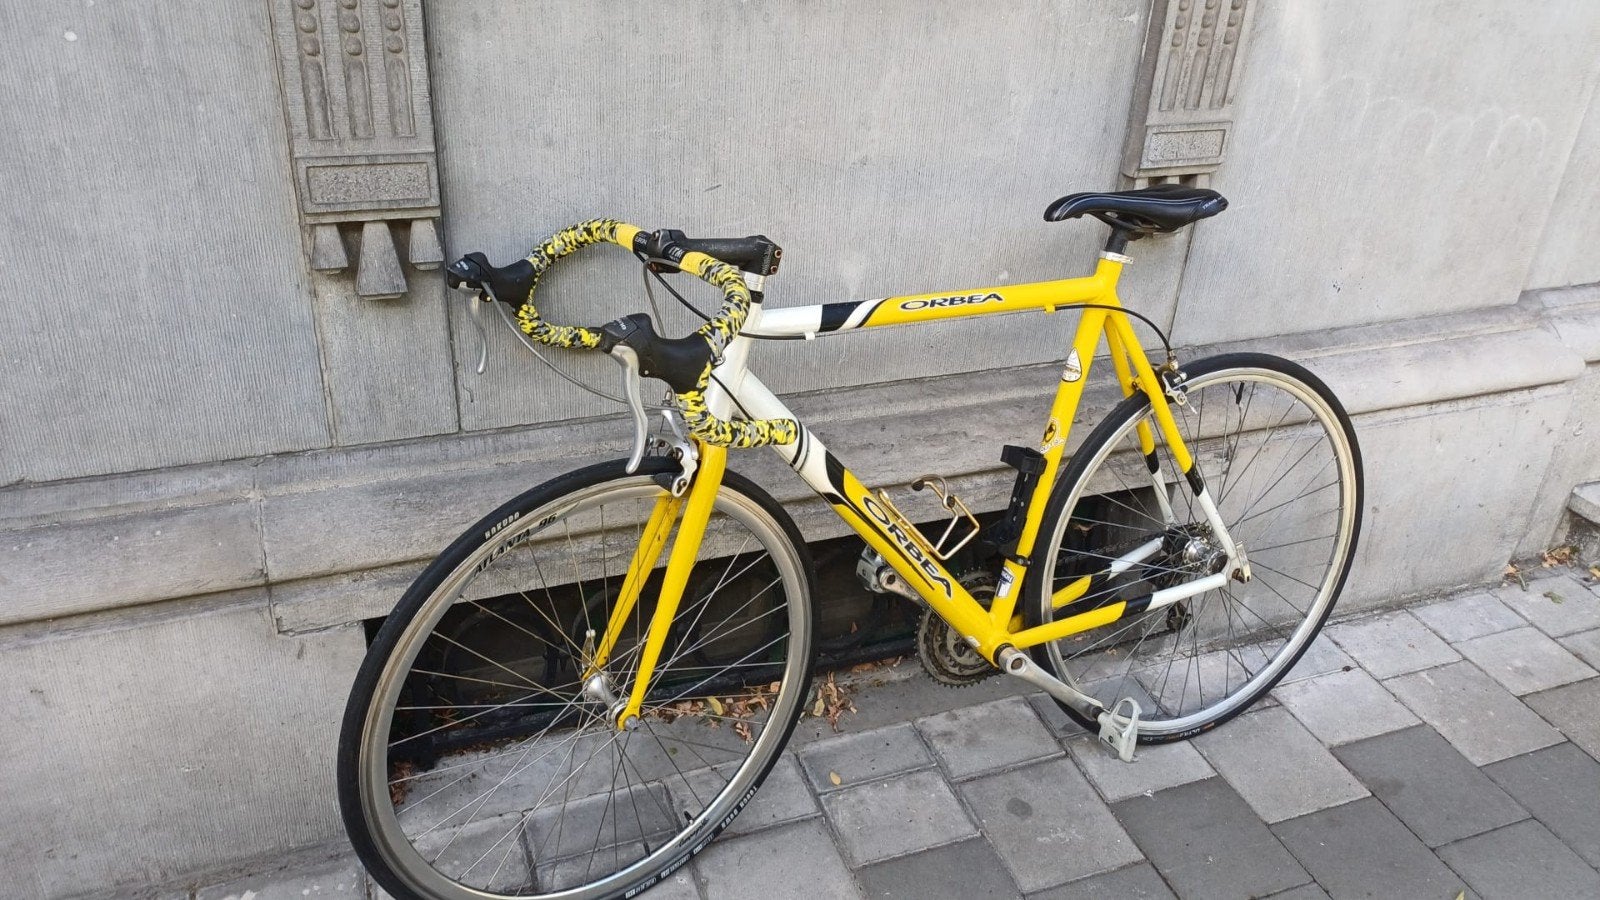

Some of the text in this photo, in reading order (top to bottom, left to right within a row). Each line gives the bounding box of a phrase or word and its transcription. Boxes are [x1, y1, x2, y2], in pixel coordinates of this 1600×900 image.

[900, 293, 1004, 310] ORBEA
[474, 529, 531, 577] ATLANTA
[862, 496, 952, 599] ORBEA
